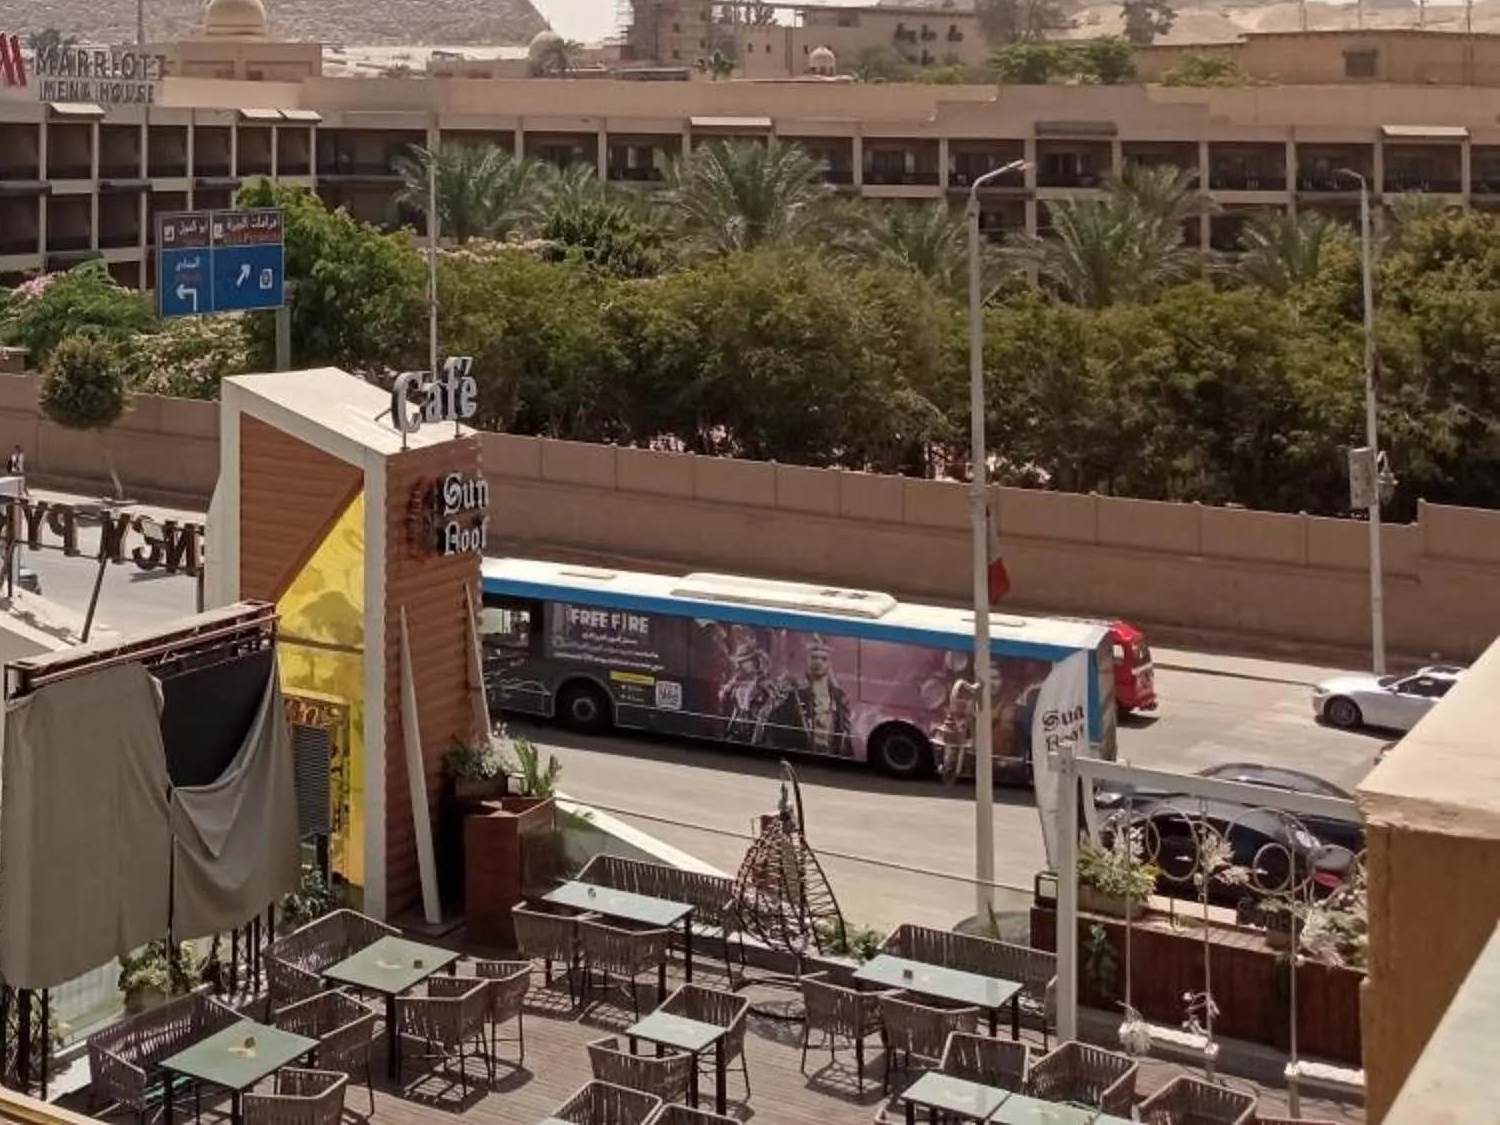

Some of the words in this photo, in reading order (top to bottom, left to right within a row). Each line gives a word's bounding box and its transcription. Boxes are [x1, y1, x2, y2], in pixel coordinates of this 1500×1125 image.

[34, 46, 169, 81] MARRIOTT
[40, 79, 91, 101] MENA
[97, 81, 156, 104] HOUSE
[442, 473, 489, 516] Sun
[570, 608, 608, 627] FREE
[611, 613, 649, 634] FIRE
